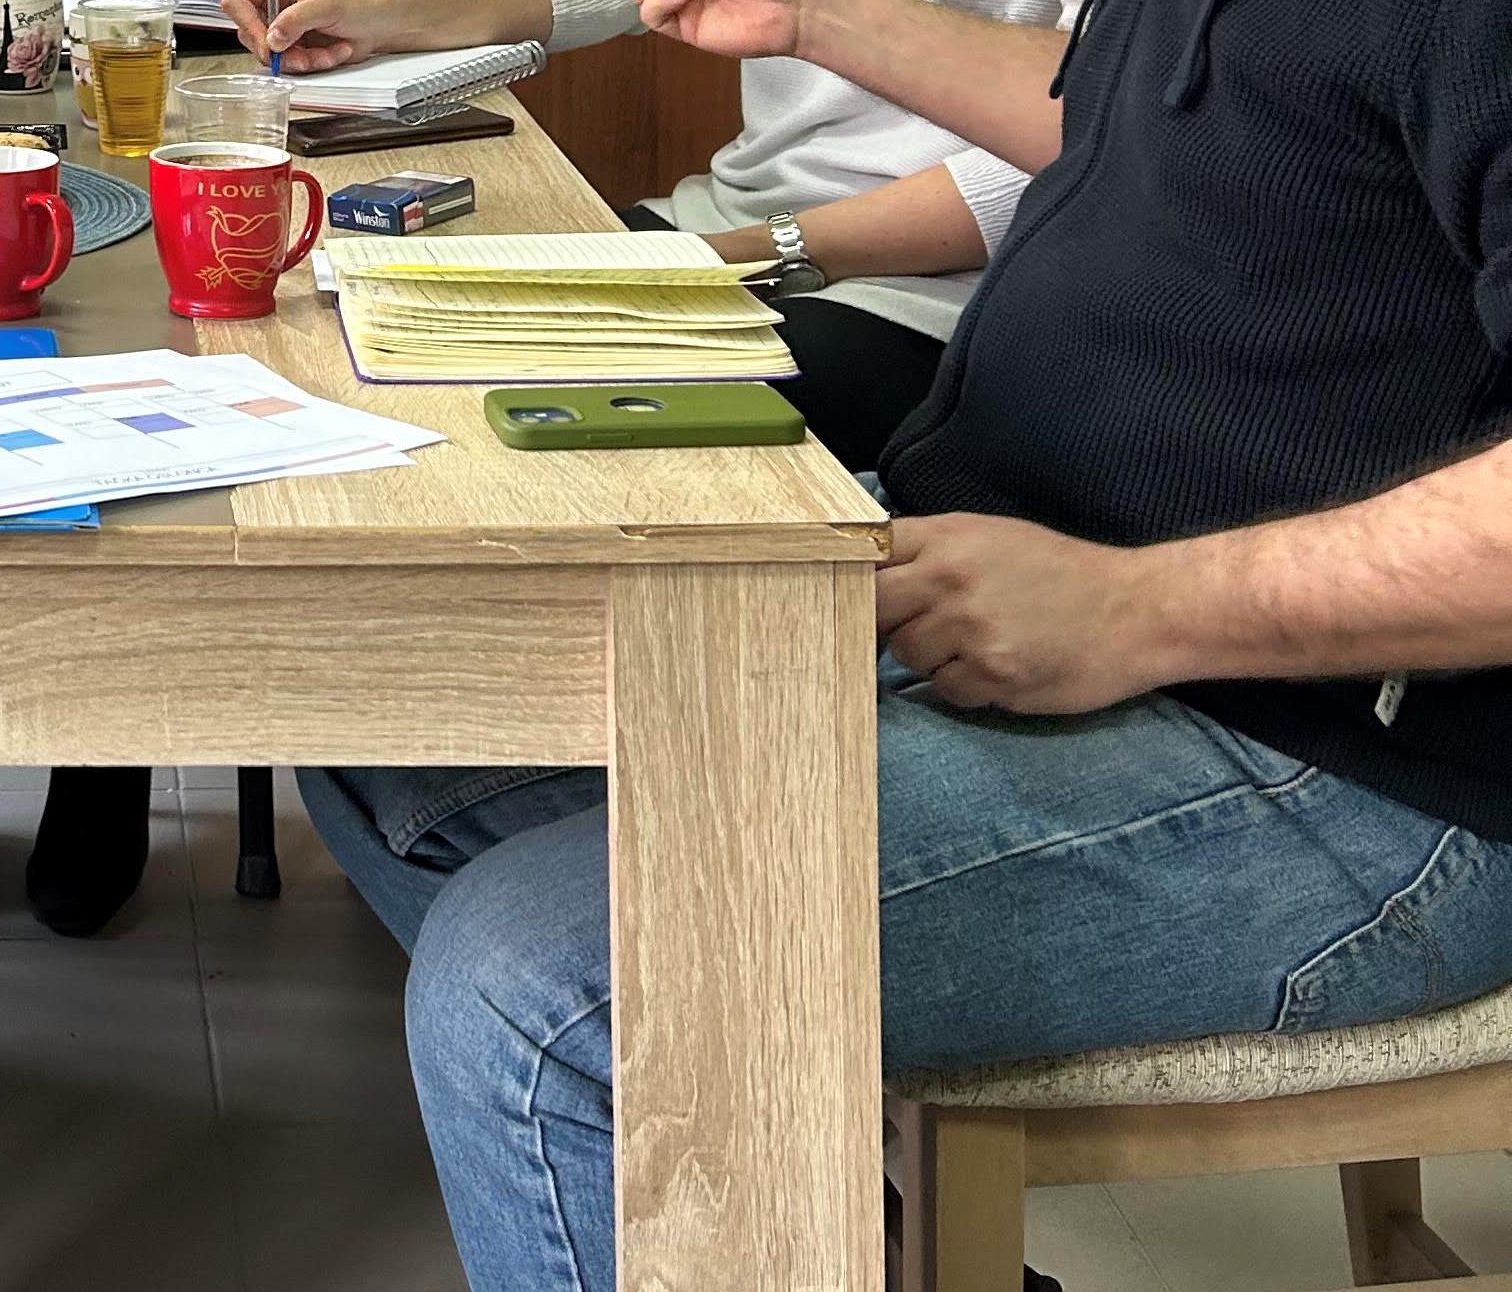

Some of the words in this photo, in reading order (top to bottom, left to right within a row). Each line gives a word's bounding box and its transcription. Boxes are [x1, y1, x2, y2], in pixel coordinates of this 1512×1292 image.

[198, 182, 204, 196] I
[210, 183, 265, 199] LOVE
[352, 208, 391, 229] Winston
